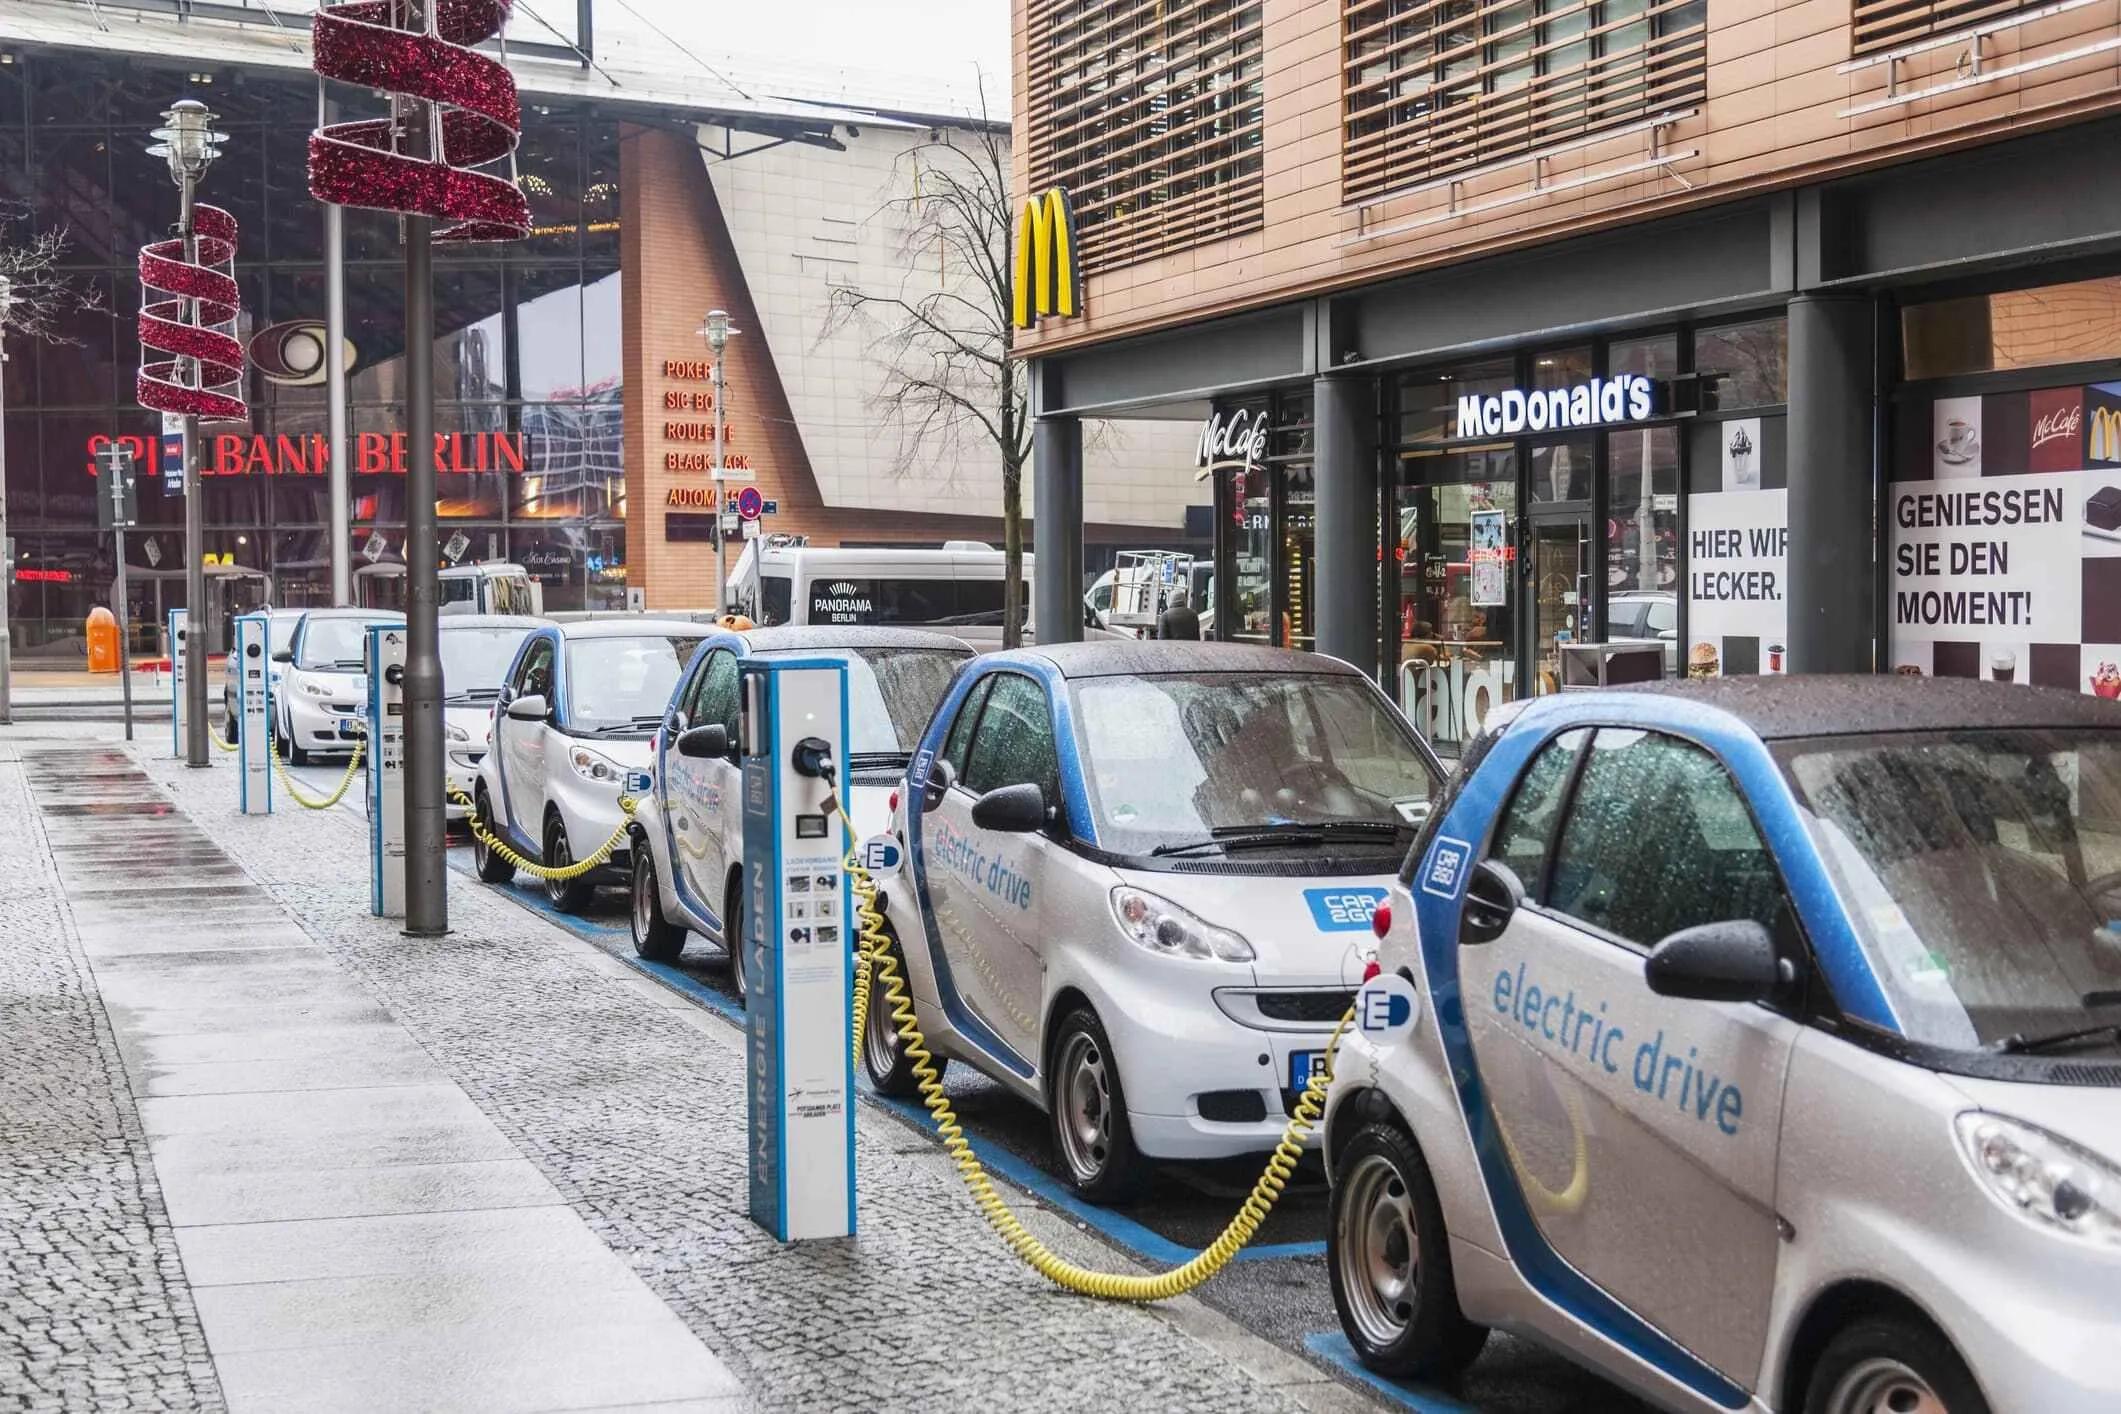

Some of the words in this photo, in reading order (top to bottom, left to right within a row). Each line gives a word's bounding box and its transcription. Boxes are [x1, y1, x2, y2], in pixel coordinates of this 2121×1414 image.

[666, 360, 712, 378] POKER
[1457, 373, 1650, 438] McDonald's
[1194, 408, 1268, 475] McCafé
[668, 452, 711, 470] BLACK
[1897, 487, 2063, 529] GENIESSEN
[1692, 529, 1743, 559] HIER
[1896, 543, 1941, 577] SIE
[1950, 541, 2009, 576] DEN
[1692, 571, 1782, 601] LECKER.
[815, 599, 872, 612] PANORAMA
[831, 613, 857, 623] BERLIN
[1897, 590, 2032, 625] MOMENT!
[935, 826, 986, 884] electric
[987, 853, 1032, 911] drive
[1323, 895, 1378, 909] CAR
[753, 861, 765, 994] LADEN
[1493, 962, 1625, 1074] electric
[1633, 1030, 1743, 1136] drive
